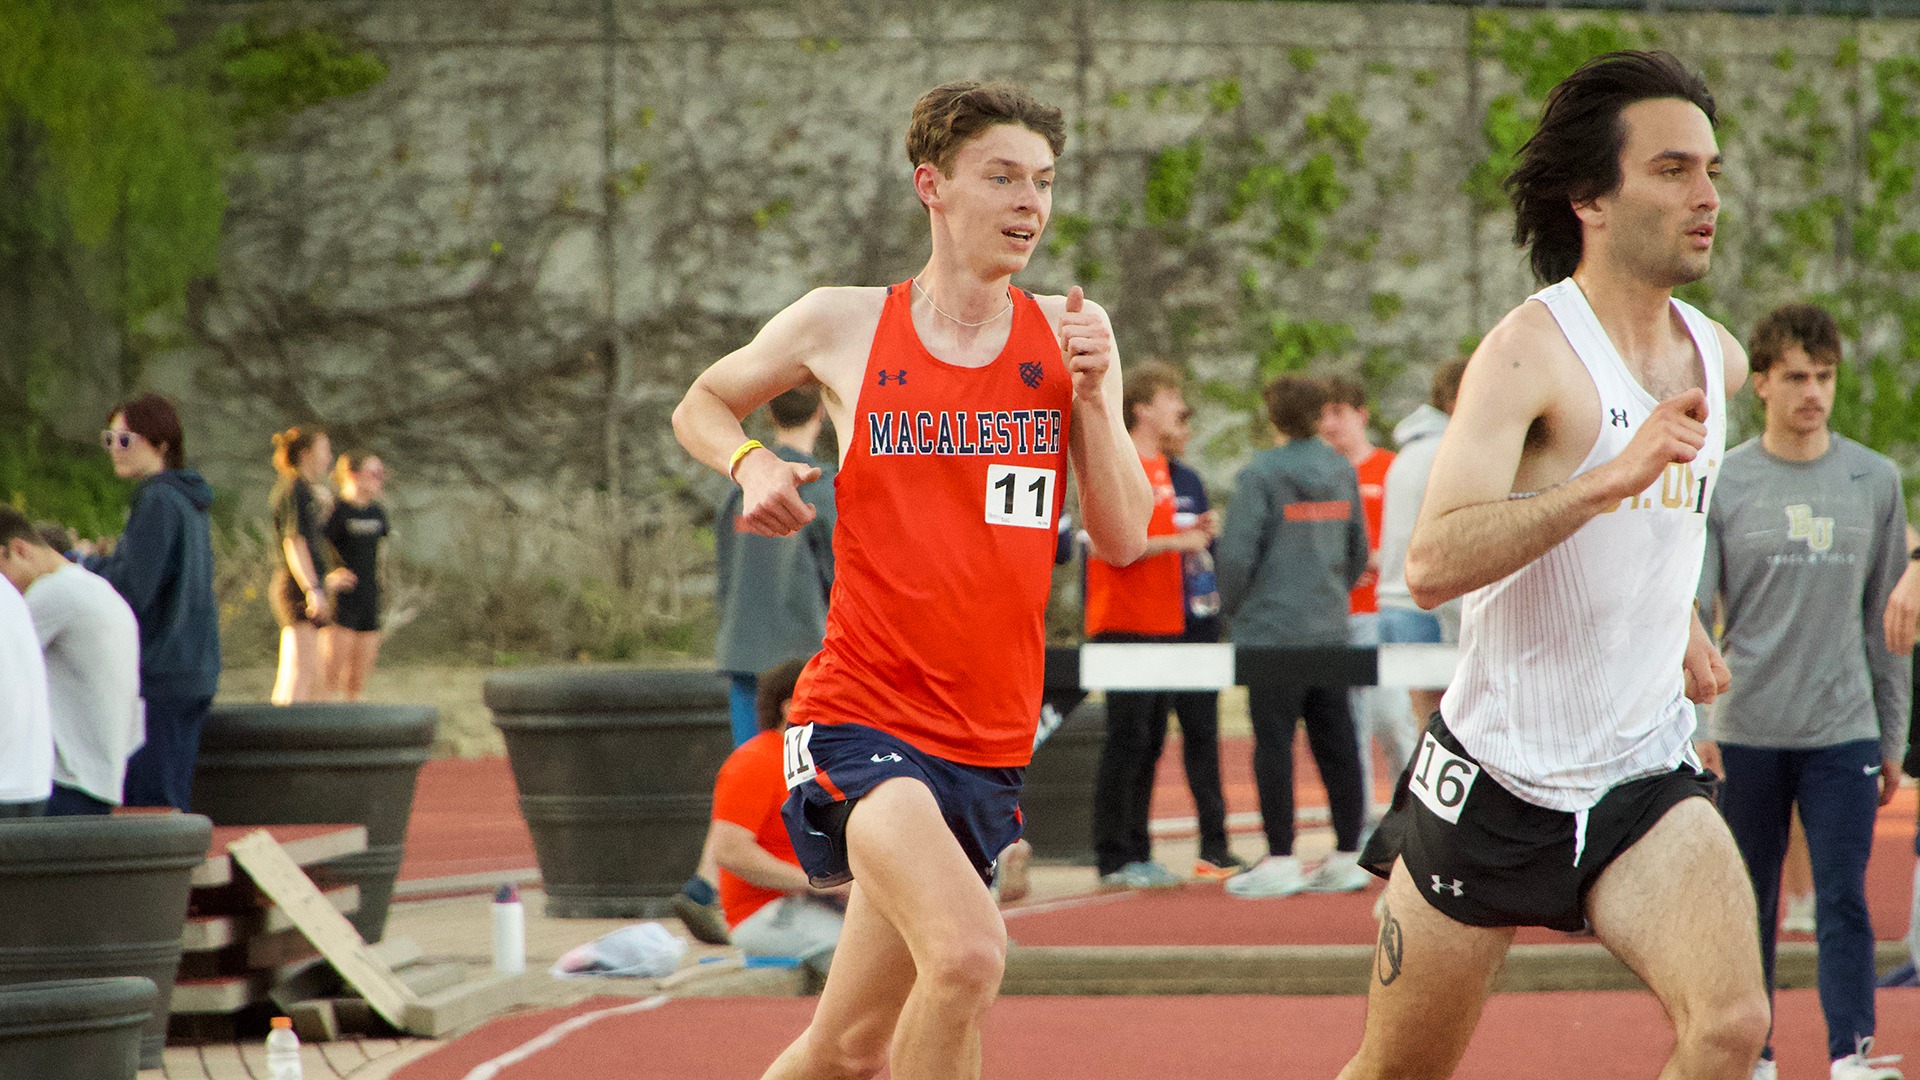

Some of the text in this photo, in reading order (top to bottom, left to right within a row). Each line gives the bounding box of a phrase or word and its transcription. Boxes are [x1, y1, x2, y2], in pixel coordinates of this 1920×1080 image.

[868, 410, 1061, 456] MACALESTER
[994, 472, 1046, 517] 11
[785, 729, 810, 780] 11
[1415, 740, 1473, 808] 16
